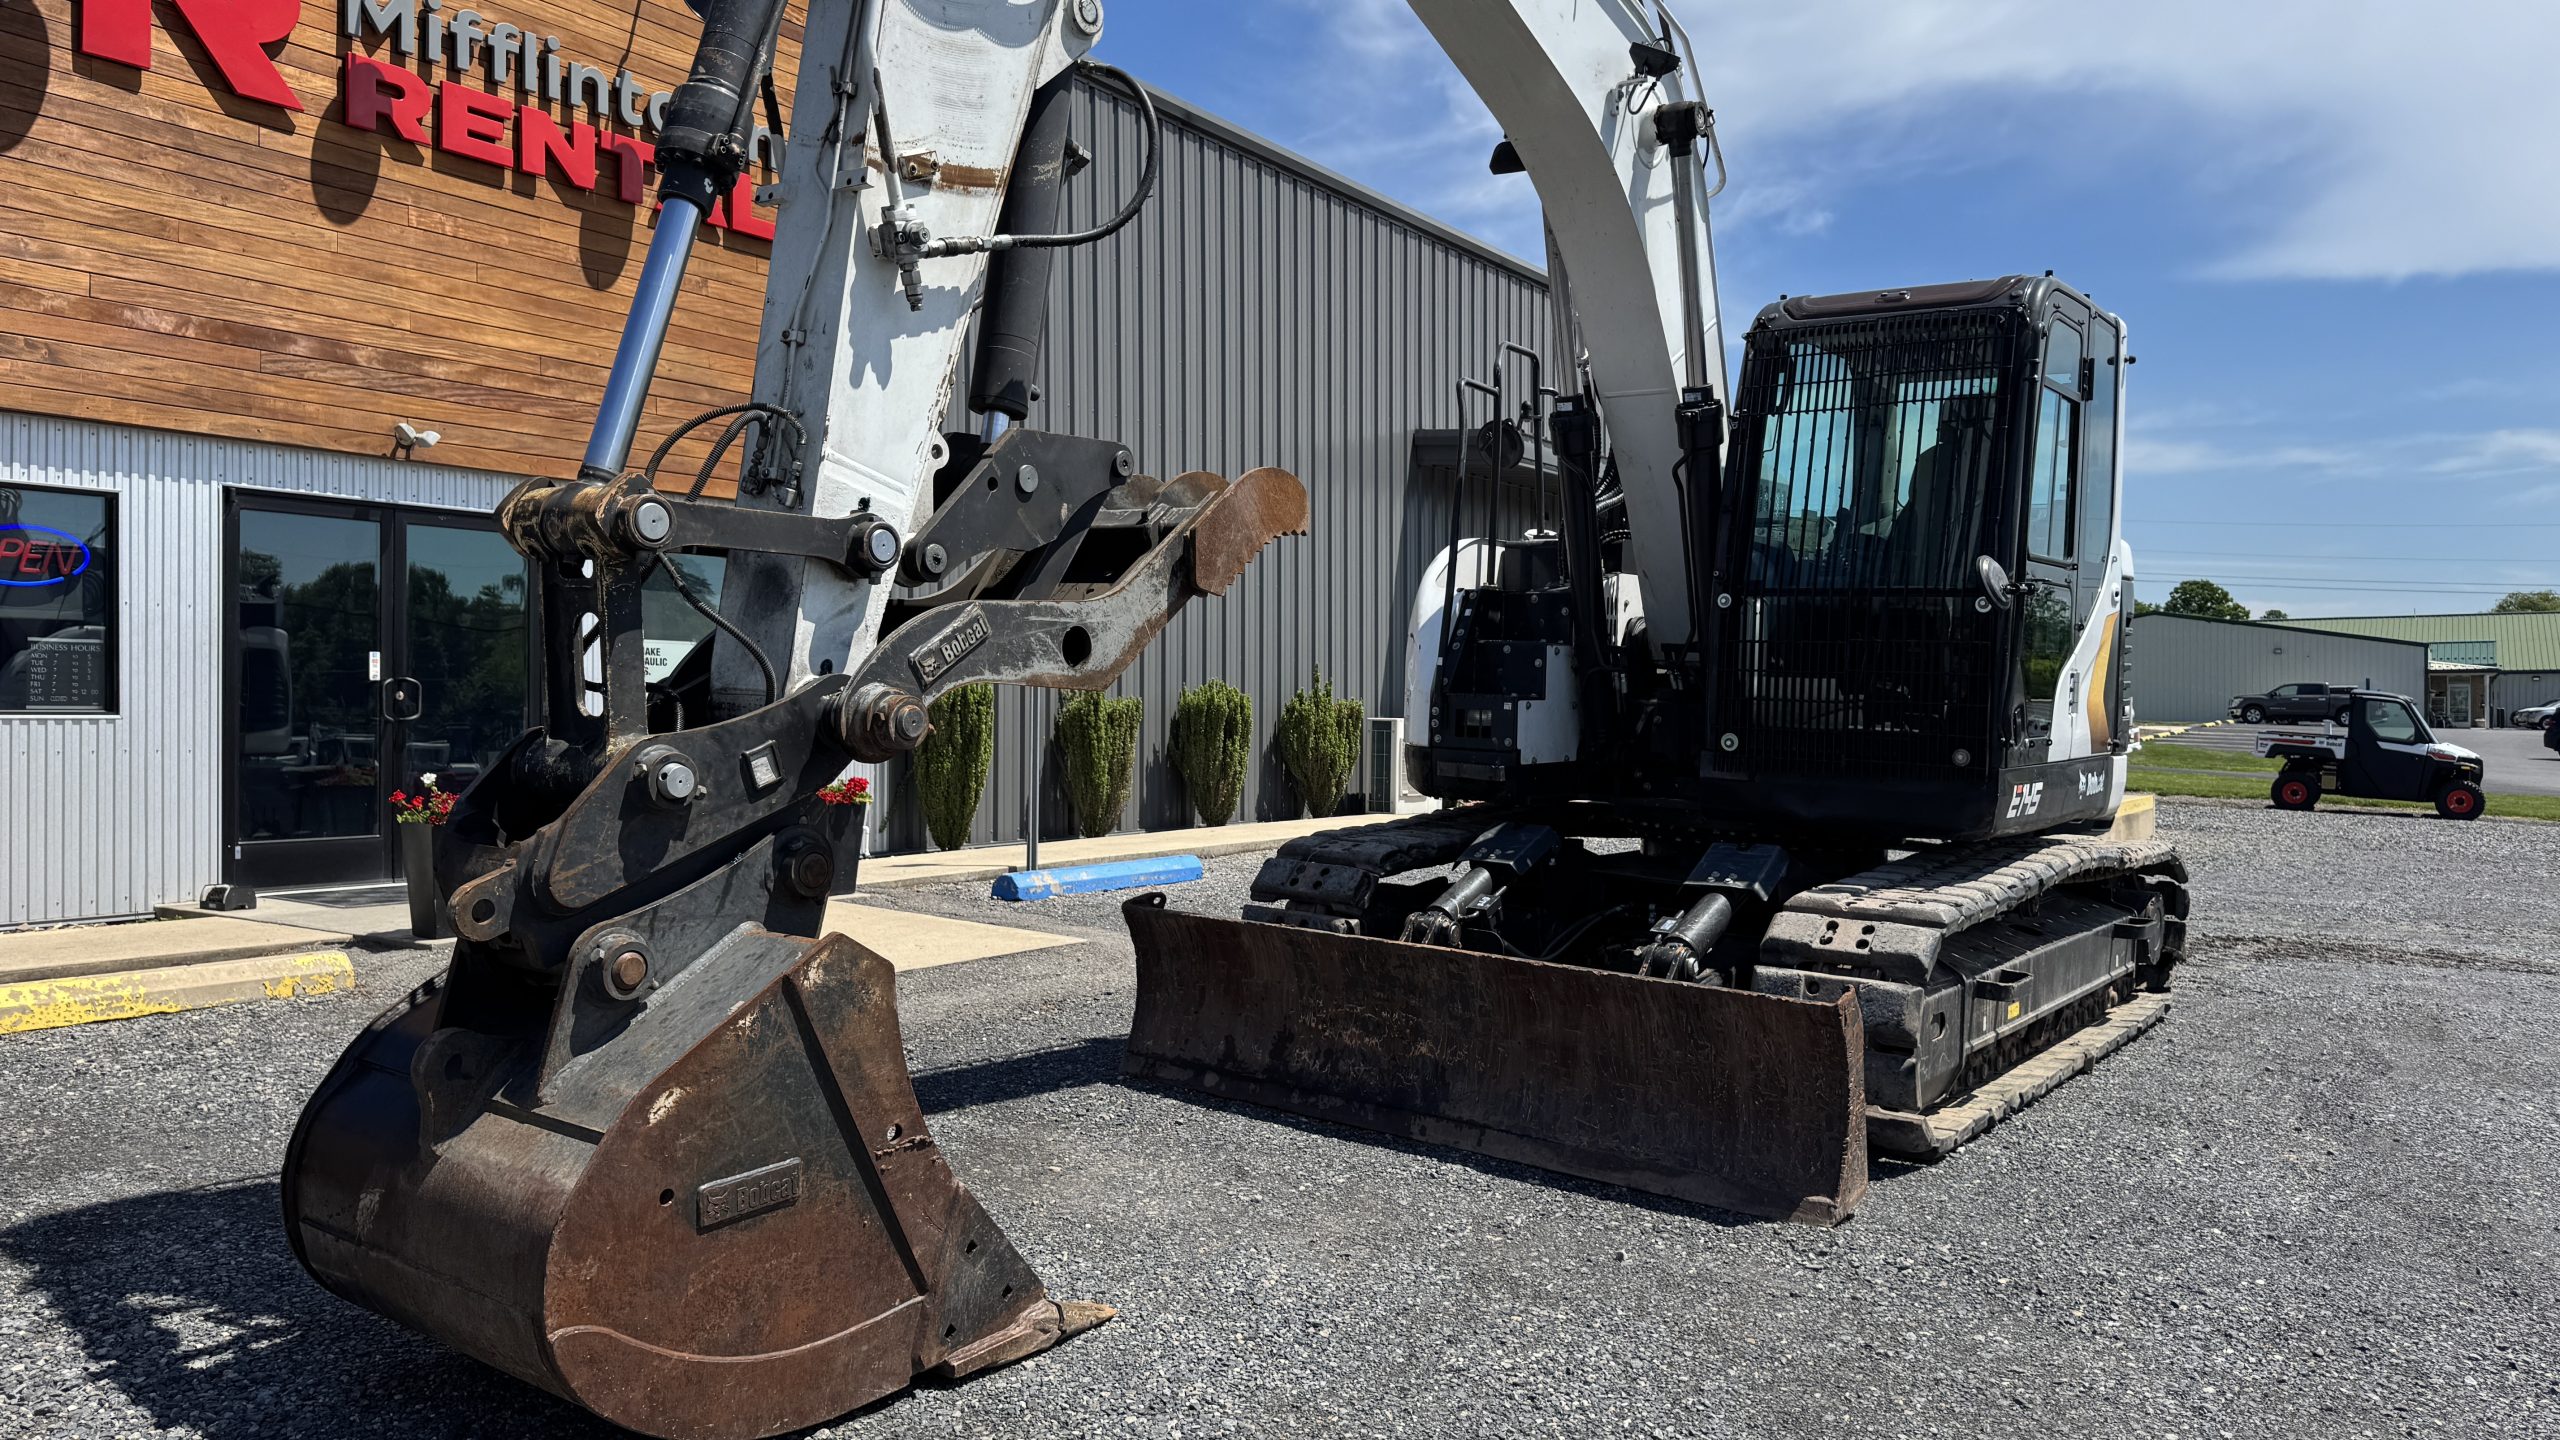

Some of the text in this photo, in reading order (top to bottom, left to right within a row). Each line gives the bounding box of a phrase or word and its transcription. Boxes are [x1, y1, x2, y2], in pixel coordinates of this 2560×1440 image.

[345, 51, 776, 240] RENTL
[30, 643, 101, 652] BUSINESS HOURS
[939, 615, 988, 665] Bobcat
